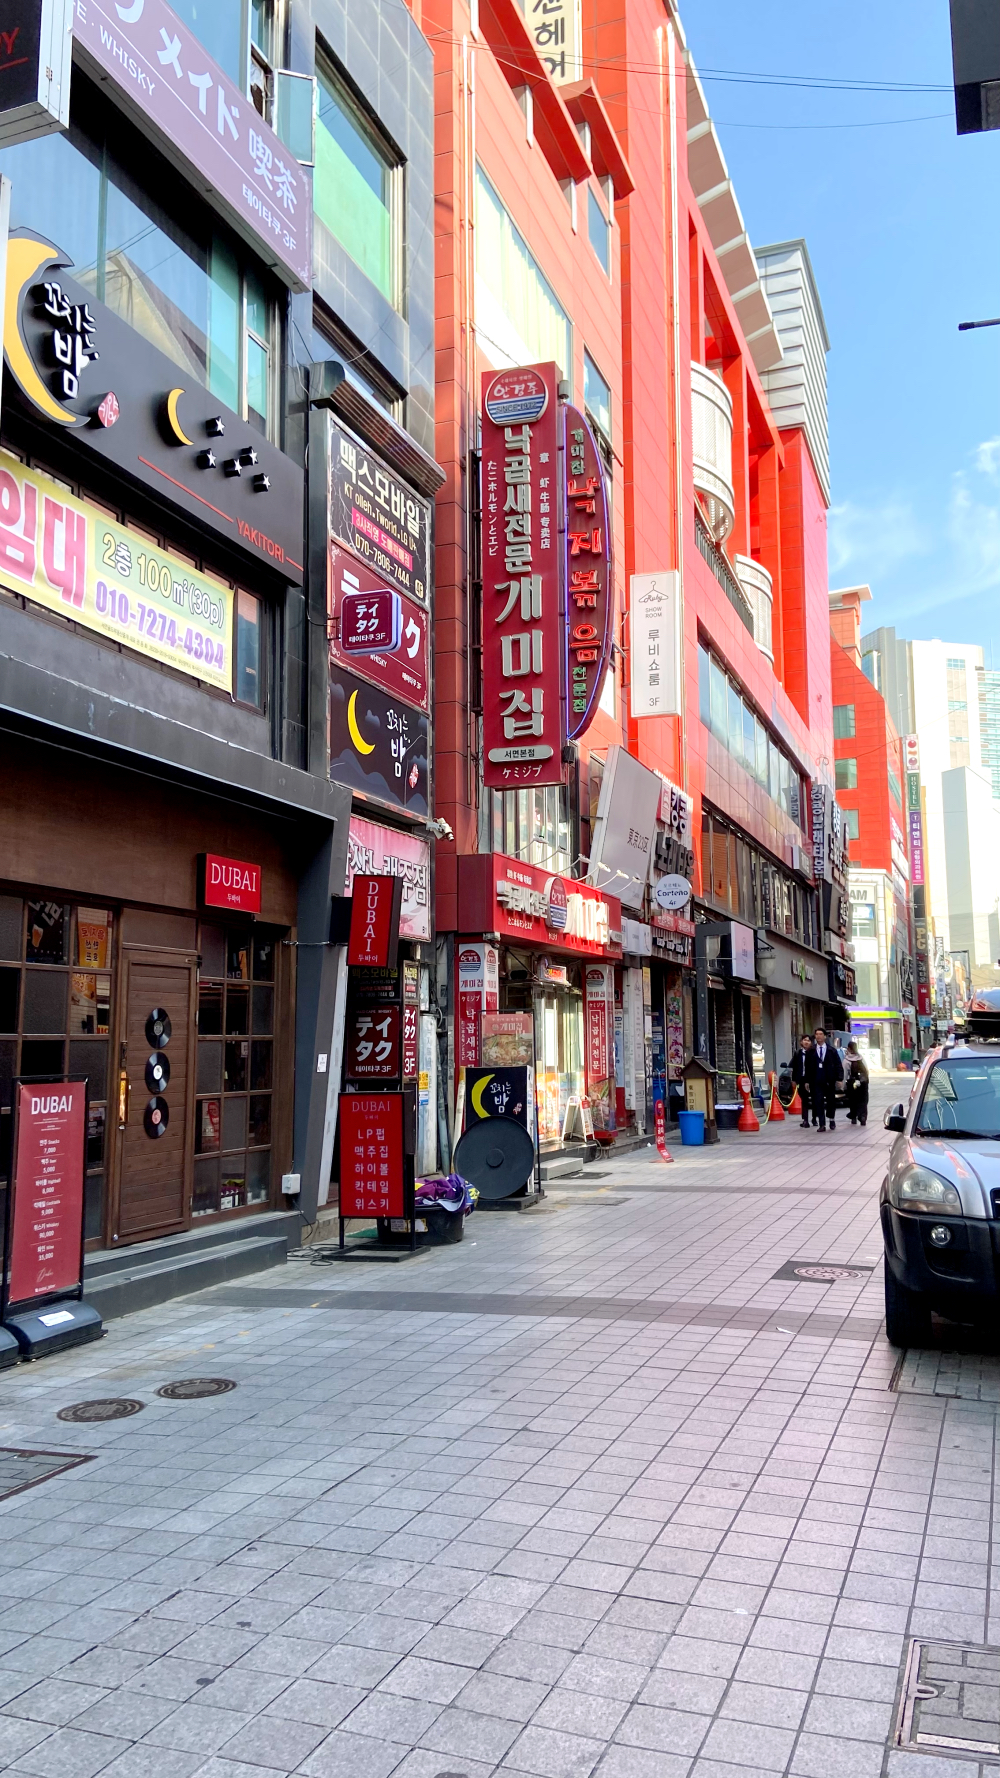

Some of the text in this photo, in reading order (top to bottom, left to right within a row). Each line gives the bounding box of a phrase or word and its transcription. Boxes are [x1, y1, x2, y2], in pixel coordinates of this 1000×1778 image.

[100, 24, 156, 96] WHISKY
[242, 183, 297, 251] 테이타쿠 3F
[54, 329, 92, 399] 밤
[494, 386, 538, 399] 안경주
[571, 428, 589, 475] 개미집
[341, 436, 420, 539] 맥스모바일
[344, 481, 354, 499] KT
[487, 461, 505, 556] たこホルモンとエビ
[504, 425, 534, 573] 낙곱새전문
[0, 469, 90, 612] 임대
[236, 516, 285, 567] YAKITORI
[102, 532, 133, 578] 2층
[355, 534, 411, 592] 070-7806-7444
[568, 477, 602, 663] 낙지볶음
[643, 594, 663, 603] Ruby
[355, 603, 379, 619] テイ
[95, 580, 226, 671] 010-7274-4304
[355, 617, 379, 634] タク
[348, 631, 387, 644] 테이타쿠 3F
[495, 574, 545, 740] 개미집
[648, 629, 661, 687] 루비쇼룸
[572, 666, 587, 713] 전문점
[649, 697, 661, 707] 3F
[391, 736, 406, 778] 밤
[504, 747, 536, 765] 서면본점
[502, 764, 543, 785] ケミジプ
[912, 822, 921, 847] 티엔티
[211, 863, 257, 892] DUBAI
[364, 881, 380, 952] DUBAI
[357, 954, 378, 964] 두바이
[460, 978, 484, 988] 개미집
[356, 1016, 393, 1038] テイ
[404, 1009, 417, 1024] テイ
[500, 1022, 523, 1031] 개미집
[404, 1024, 417, 1040] タク
[465, 1008, 477, 1067] 낙곱새전
[591, 1014, 601, 1070] 낙곱새전문
[355, 1040, 393, 1063] タク
[355, 1065, 392, 1074] 테이타쿠 3F
[404, 1057, 417, 1073] 3F
[31, 1095, 73, 1115] DUBAI
[352, 1101, 391, 1112] DUBAI
[354, 1145, 389, 1159] 맥주집
[354, 1163, 389, 1176] 하이볼
[354, 1180, 389, 1194] 칵테일
[354, 1198, 389, 1211] 위스키
